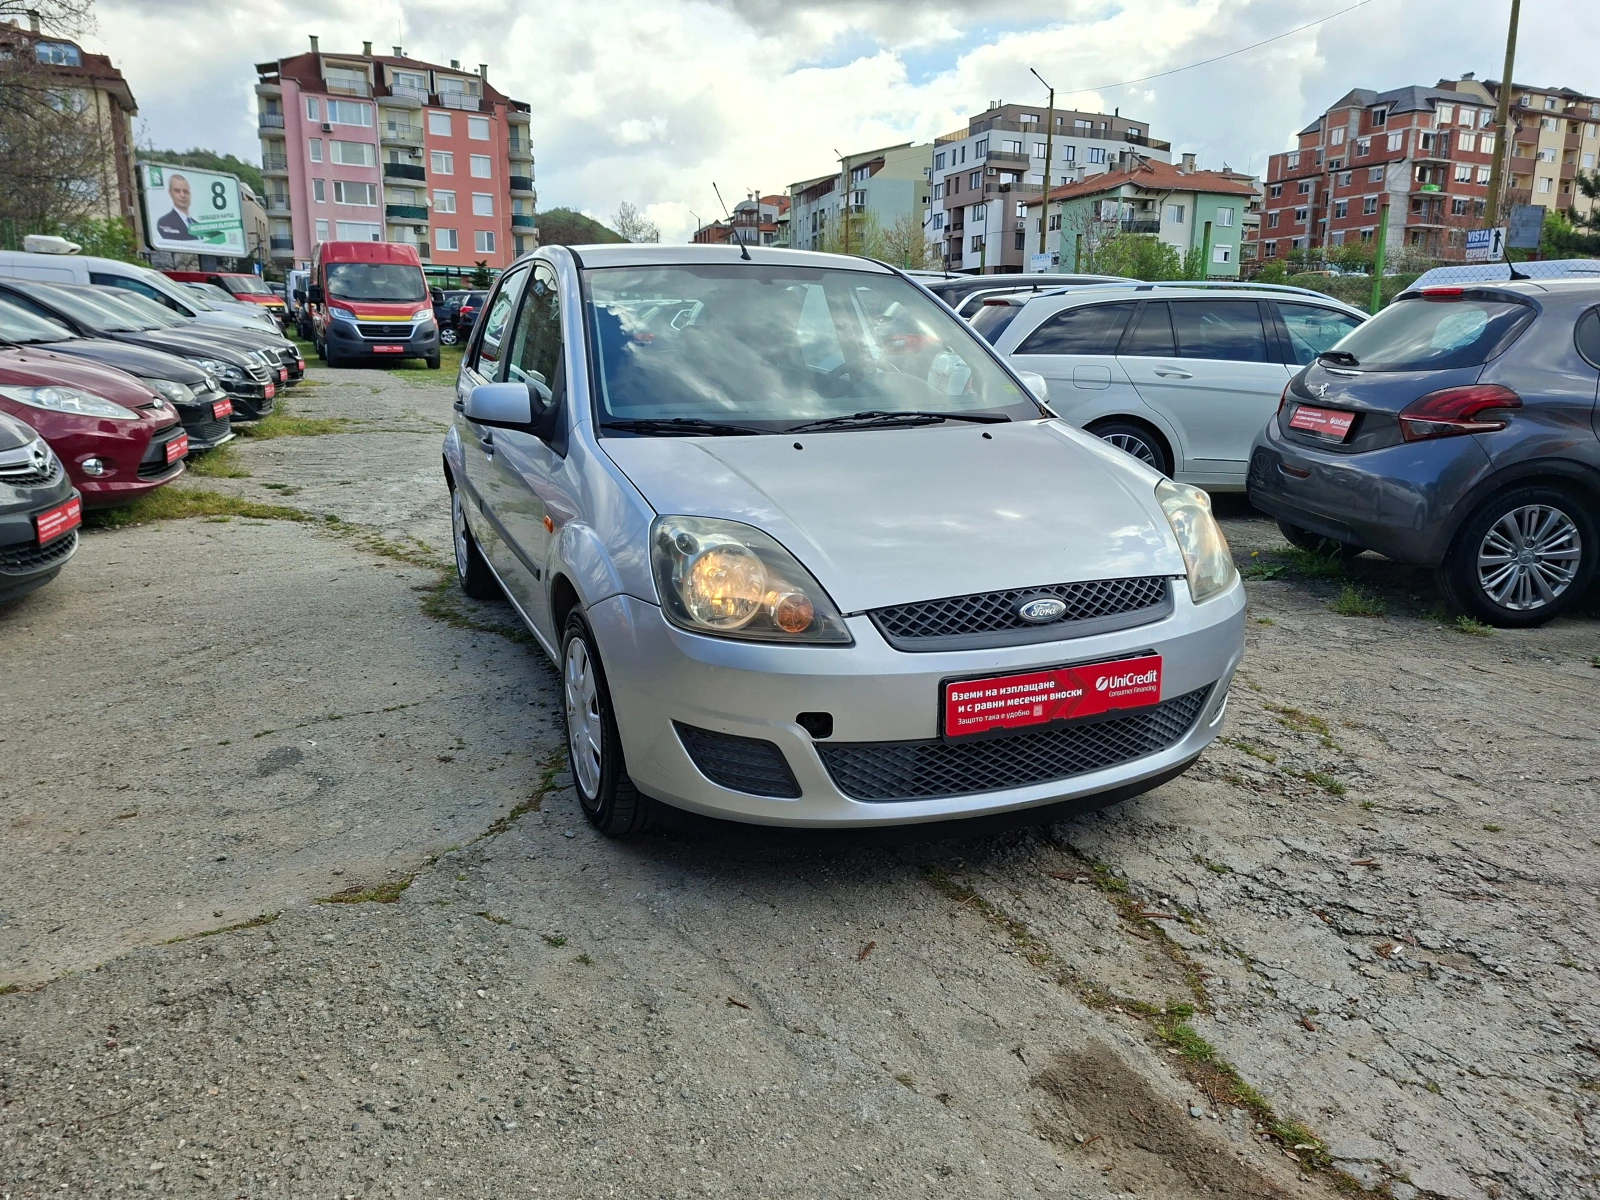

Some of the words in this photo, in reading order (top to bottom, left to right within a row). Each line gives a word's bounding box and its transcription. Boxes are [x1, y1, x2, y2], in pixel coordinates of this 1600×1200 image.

[211, 181, 227, 210] 8
[198, 213, 220, 221] СВОБОДЕН
[218, 221, 239, 229] БЪЛГАРИЯ
[1468, 230, 1489, 242] VISTA
[1466, 249, 1487, 258] СЕРВИЗ
[1031, 603, 1057, 616] Ford
[1109, 670, 1157, 689] UniCredit
[952, 690, 983, 701] Вземи
[985, 688, 997, 696] на
[1000, 681, 1055, 694] изплащане
[1109, 688, 1133, 697] Consumer
[1134, 685, 1156, 693] Financing
[958, 705, 964, 713] и
[974, 700, 1004, 712] равни
[1007, 694, 1047, 706] месечни
[1049, 689, 1082, 700] вноски
[957, 716, 983, 725] Защото
[1006, 709, 1030, 719] удобно
